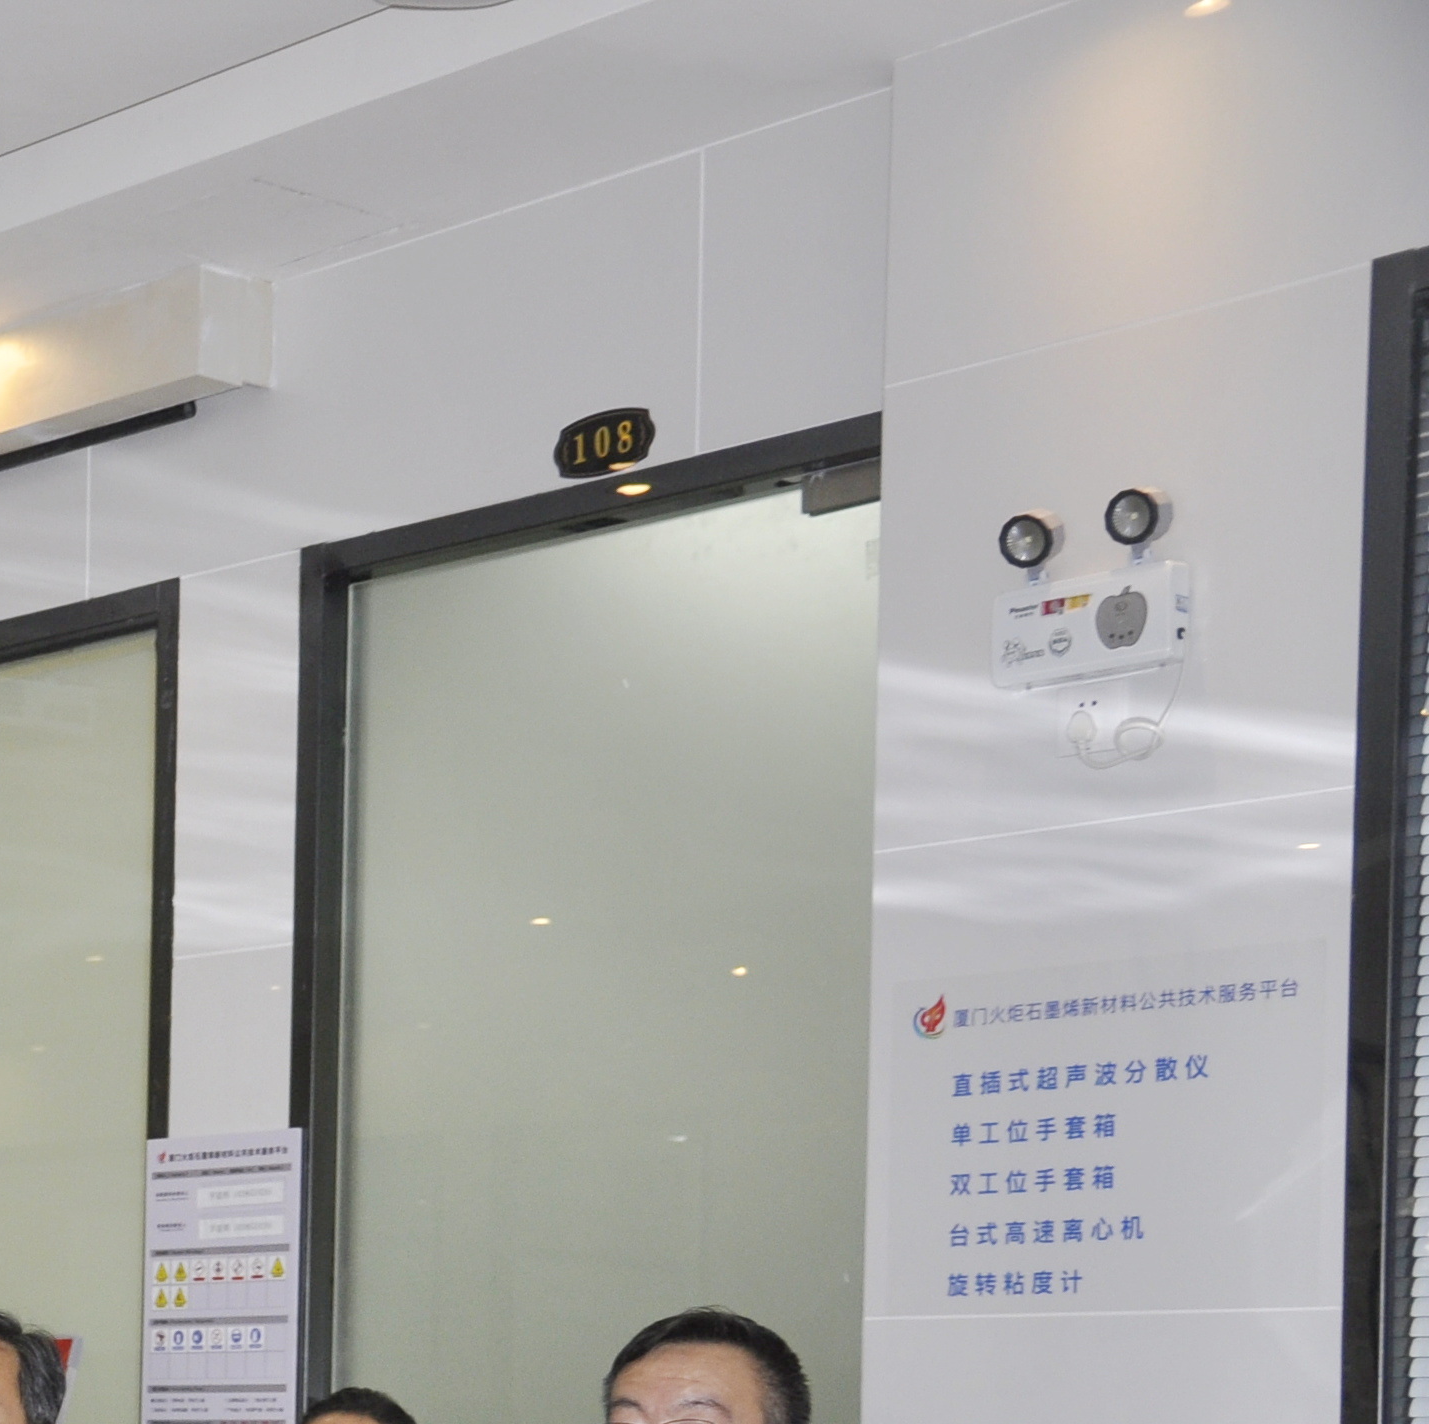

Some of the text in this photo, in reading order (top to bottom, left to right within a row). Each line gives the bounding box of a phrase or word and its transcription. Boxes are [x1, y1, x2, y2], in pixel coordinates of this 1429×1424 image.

[573, 420, 633, 464] 108
[953, 979, 1299, 1027] 厦门火炬石墨烯新材料公共技术服务平台
[951, 1054, 1211, 1098] 直插式超声波分散仪
[951, 1113, 1117, 1147] 单工位手套箱
[950, 1165, 1116, 1197] 双工位手套箱
[949, 1215, 1146, 1248] 台式高速离心机
[946, 1270, 1084, 1298] 旋转粘度计
